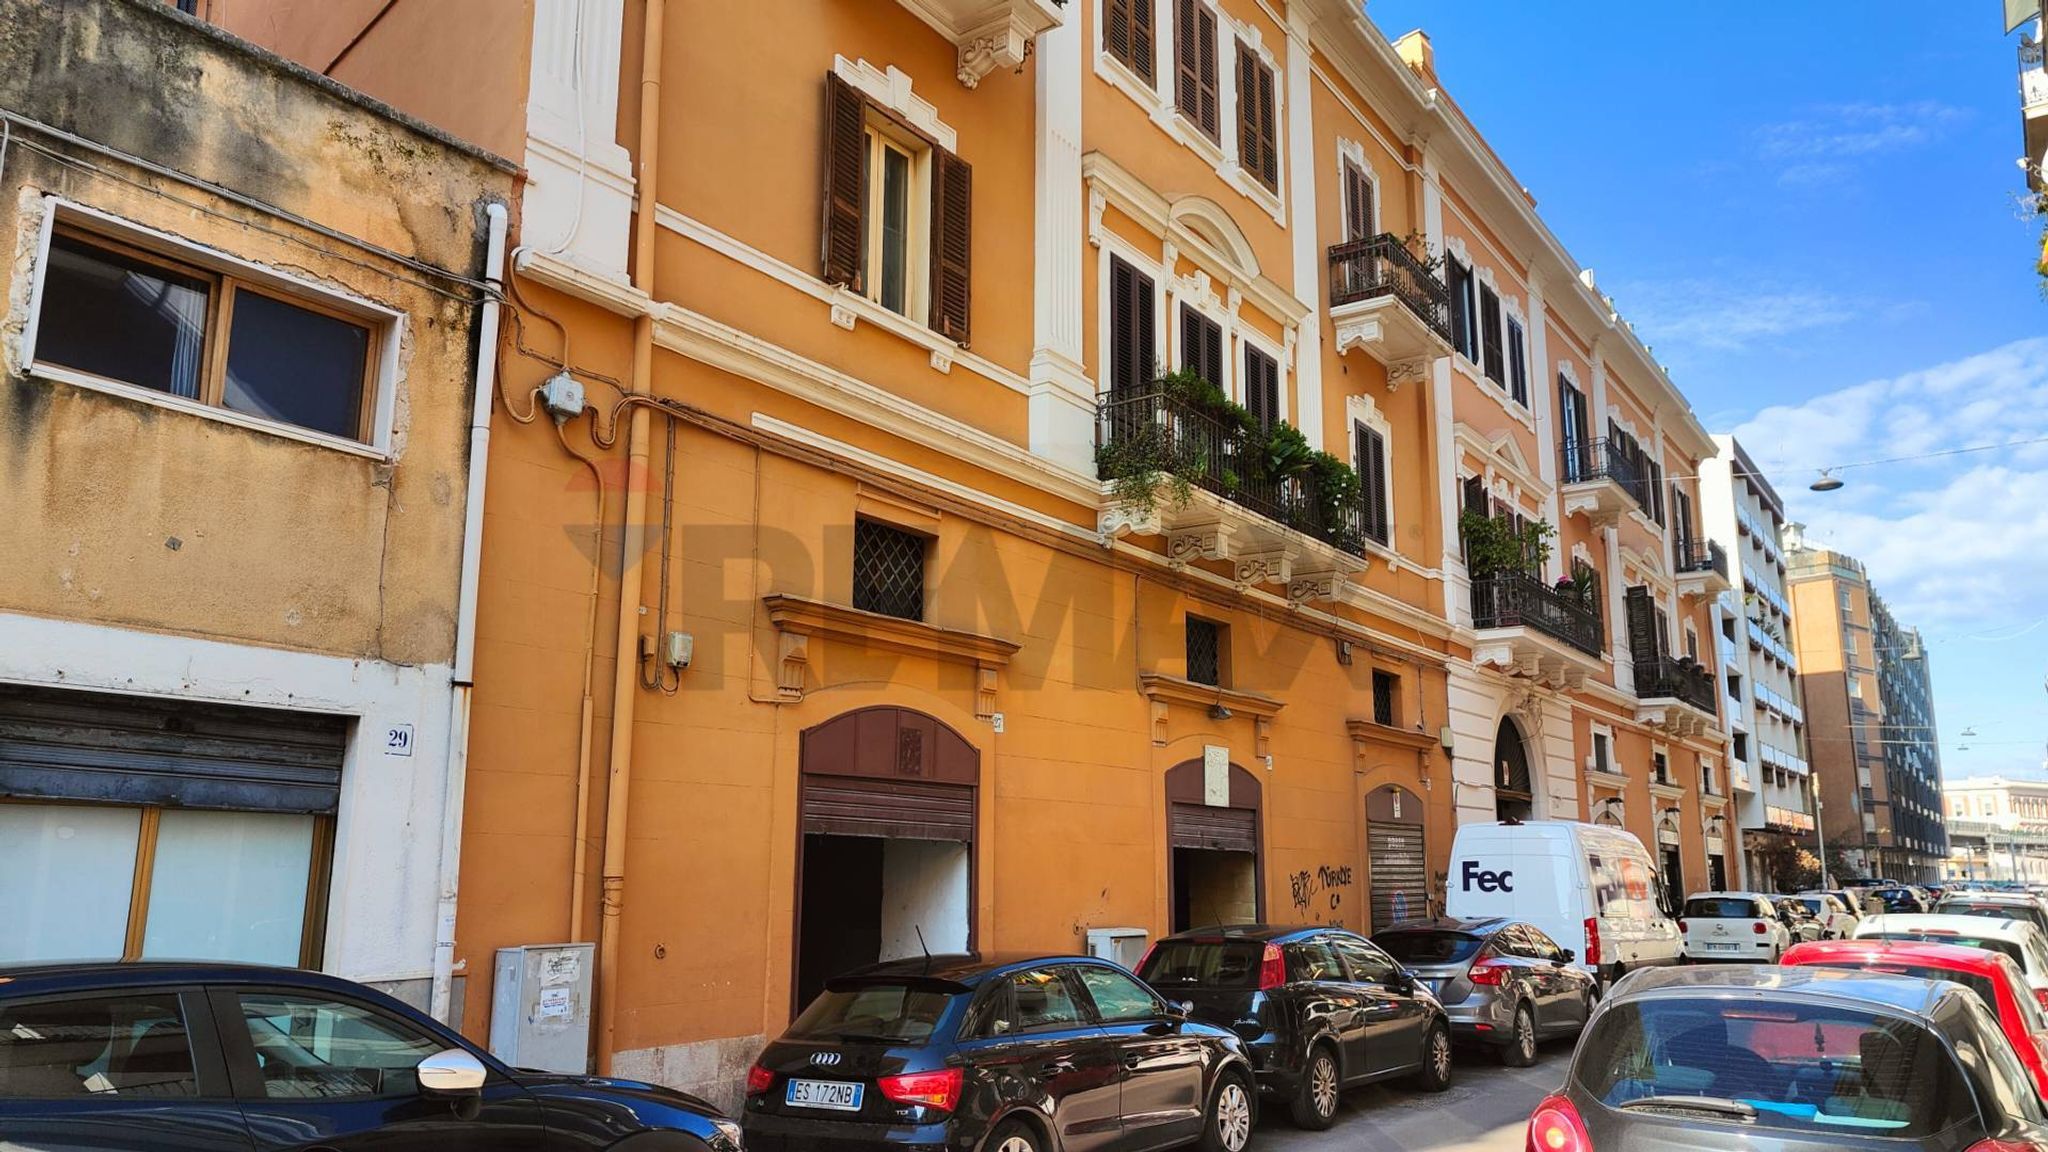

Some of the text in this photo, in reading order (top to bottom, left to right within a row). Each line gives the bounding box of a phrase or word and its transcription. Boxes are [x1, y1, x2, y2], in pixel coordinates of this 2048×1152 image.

[388, 729, 408, 748] 29
[795, 1083, 853, 1104] ES 172NB
